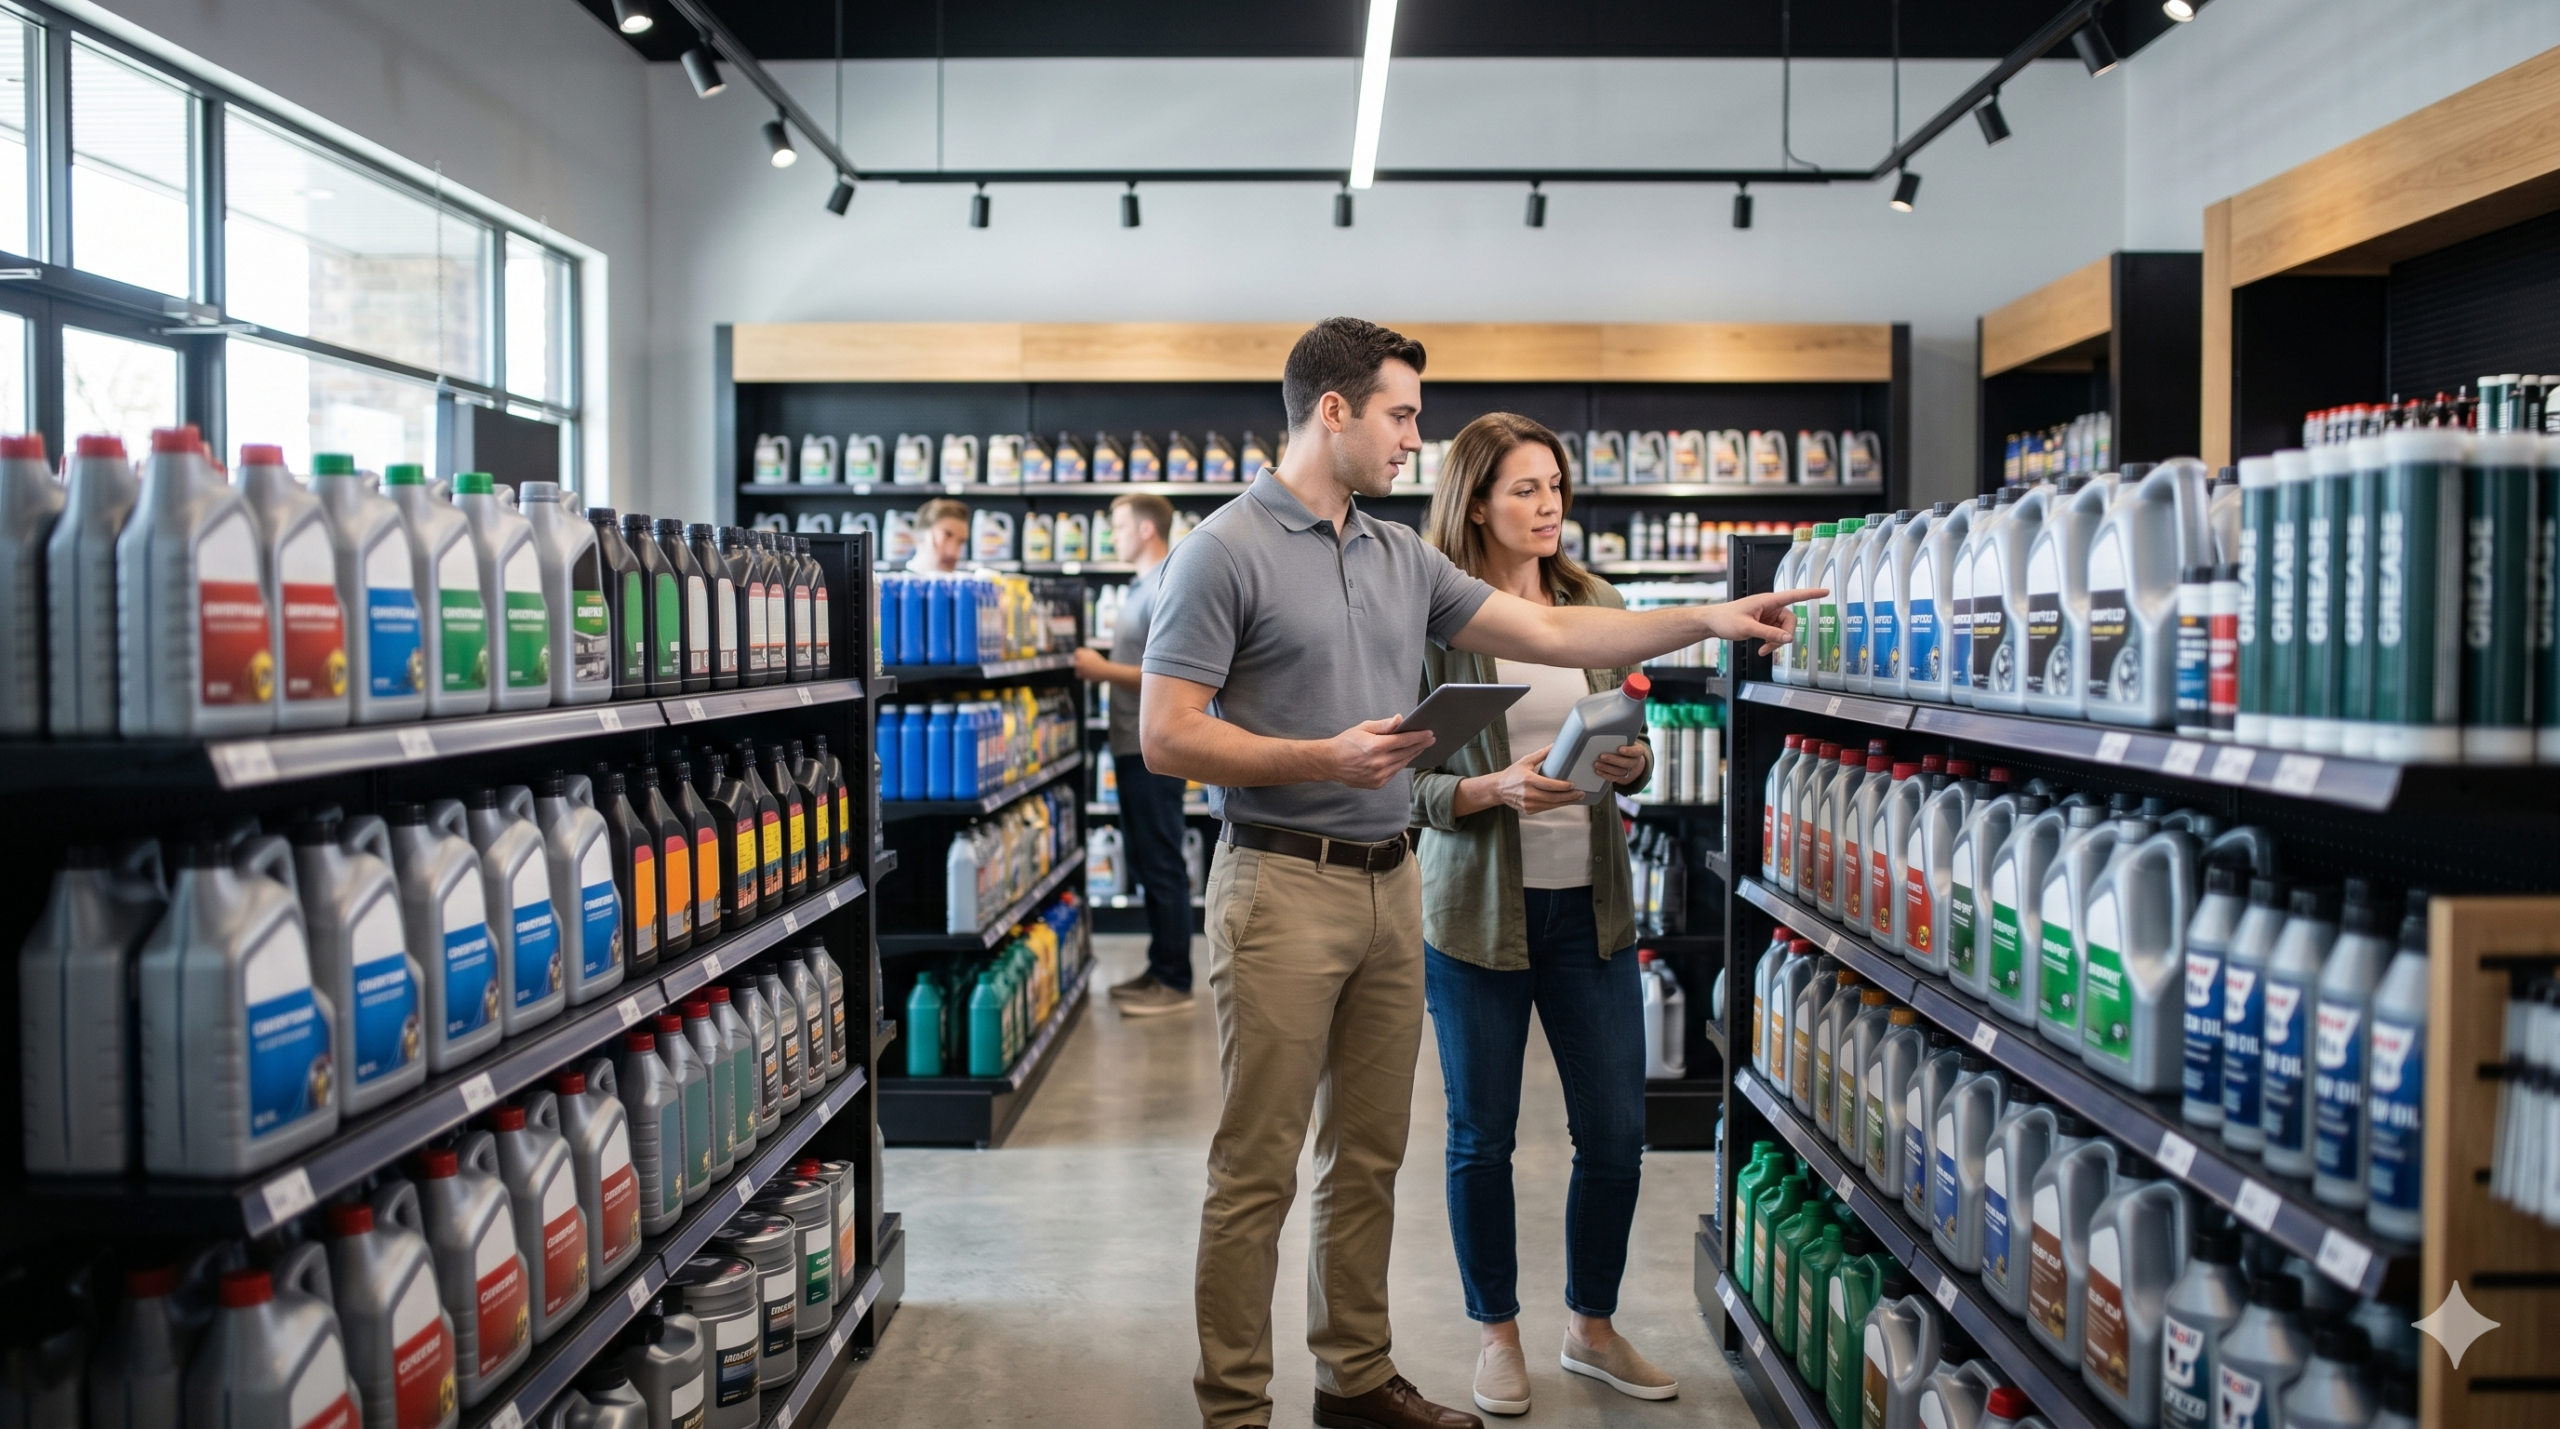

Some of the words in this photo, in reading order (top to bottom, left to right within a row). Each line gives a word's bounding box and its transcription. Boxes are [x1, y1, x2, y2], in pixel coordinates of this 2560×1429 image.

[2271, 521, 2295, 646] GREASE
[2306, 517, 2330, 646] GREASE
[2344, 513, 2365, 647] GREASE
[2377, 510, 2403, 648] GREASE
[2201, 1016, 2225, 1038] OIL
